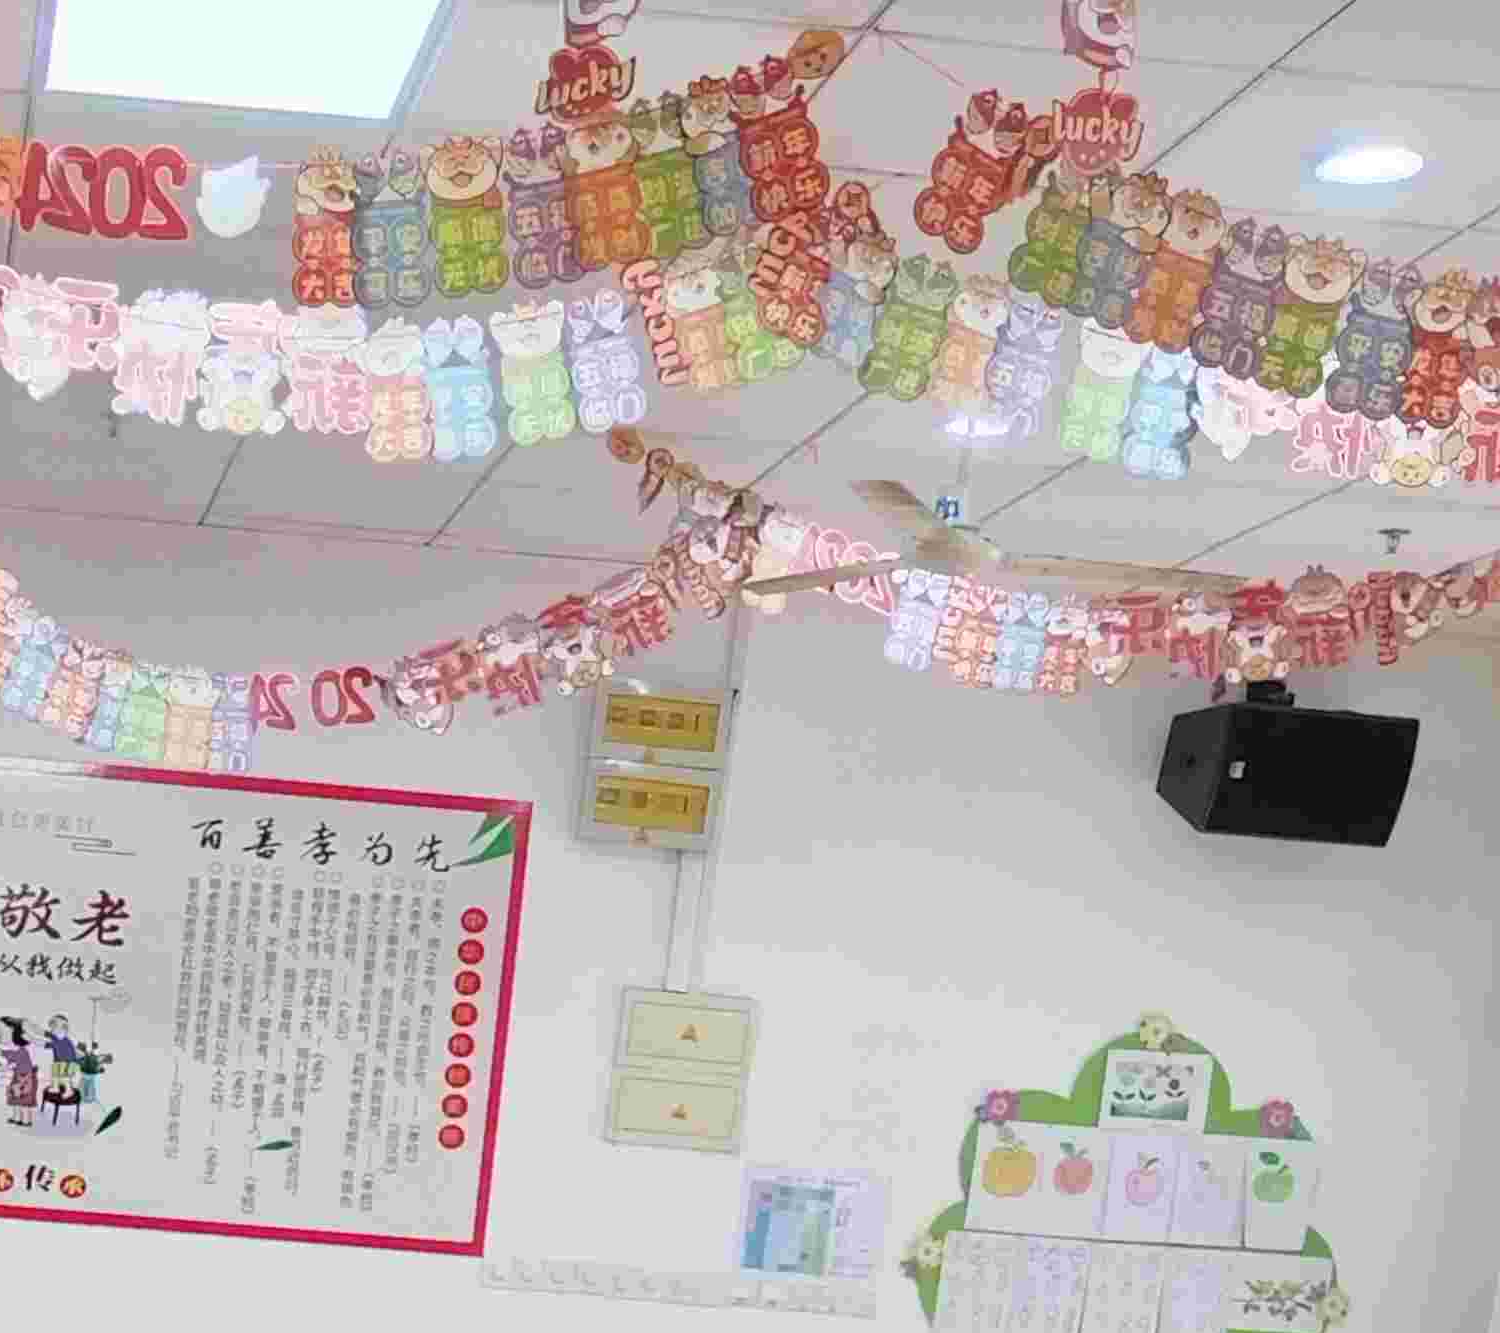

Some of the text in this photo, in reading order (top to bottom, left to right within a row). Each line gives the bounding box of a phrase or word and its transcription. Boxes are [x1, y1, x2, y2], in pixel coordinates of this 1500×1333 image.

[191, 817, 450, 872] 百善孝为先
